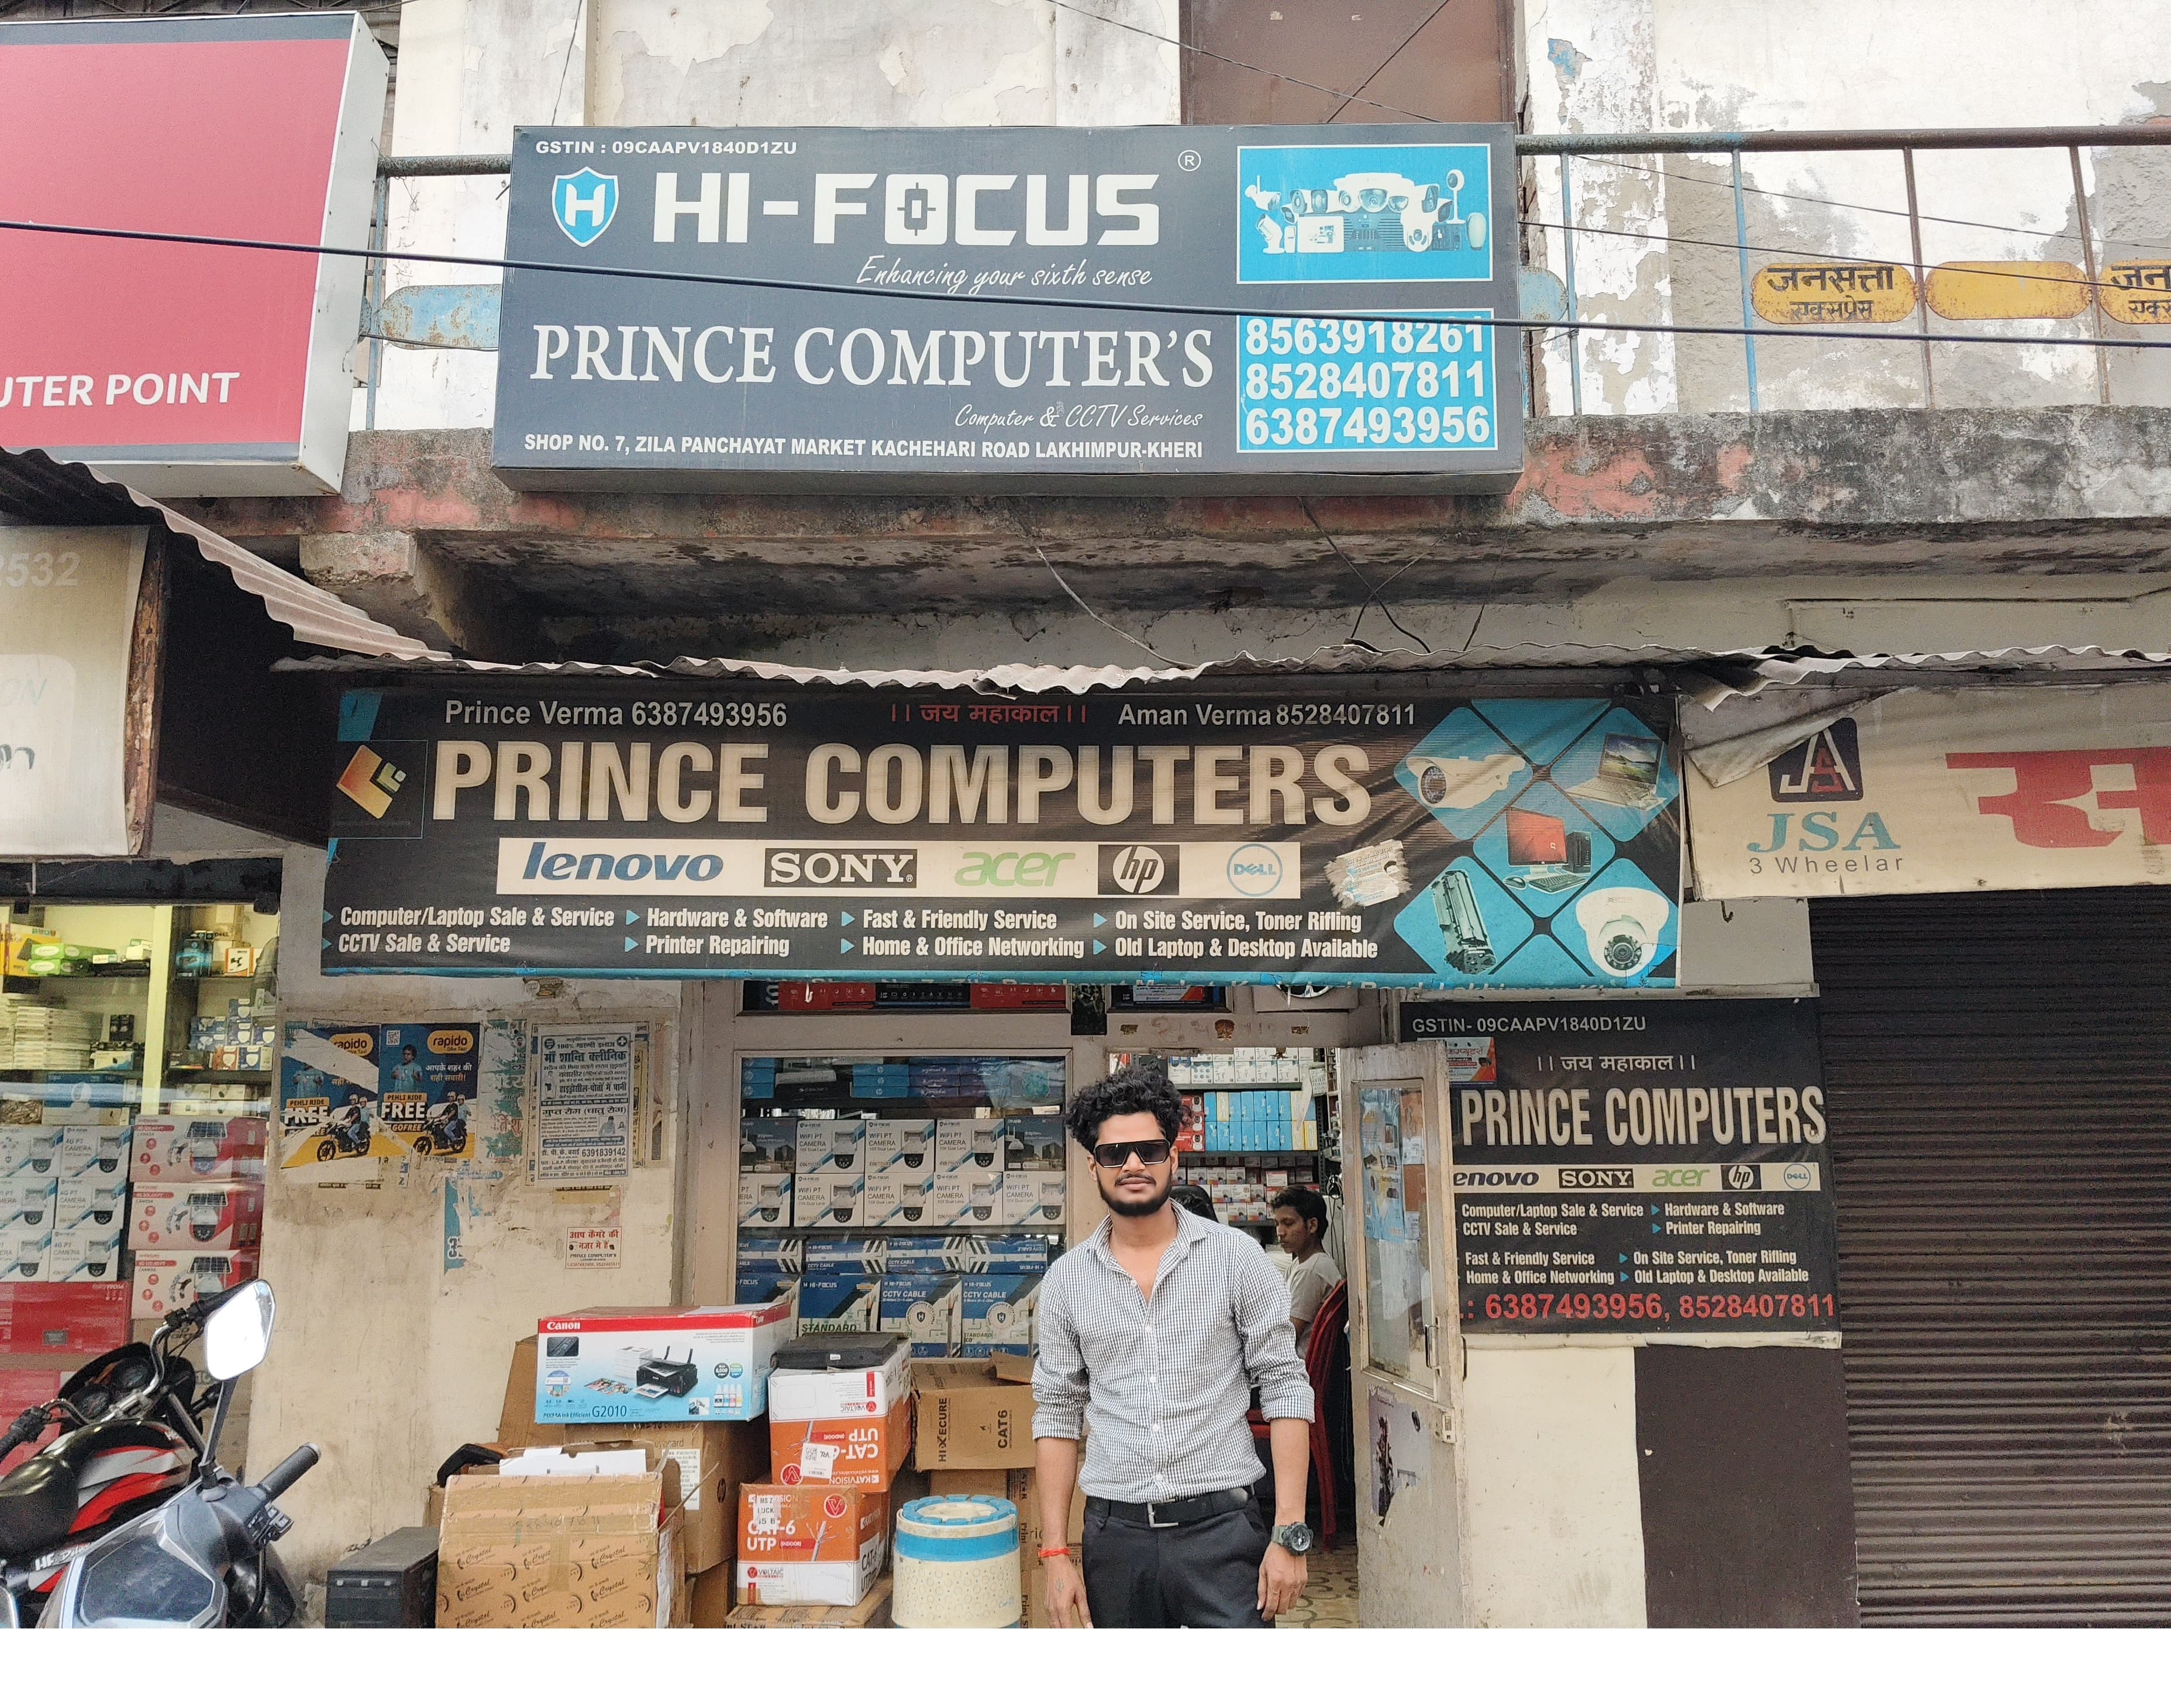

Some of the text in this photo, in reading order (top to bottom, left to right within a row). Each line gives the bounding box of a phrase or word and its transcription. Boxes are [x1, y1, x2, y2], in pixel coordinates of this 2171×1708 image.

[536, 142, 797, 155] GSTIN 09CAAPV1840D1ZU
[653, 173, 1160, 246] HI-FOCUS
[857, 254, 1152, 295] Enhancing your sixth sense
[1246, 316, 1485, 356] 8563918261
[530, 325, 776, 383] PRINCE
[106, 371, 240, 405] POINT
[1246, 360, 1486, 401] 8528407811
[956, 404, 1203, 434] Computer & CCTV Services
[1246, 406, 1490, 445] 6387493956
[525, 434, 1203, 459] SHOP NO. 7, ZILA PANCHAYAT MARKET KACHEHARI ROAD LAKHIMPUR-KHERI
[446, 700, 787, 727] Prince Verma 6387493956
[920, 704, 1059, 724] जय महाकाल
[1118, 704, 1415, 725] Aman Verma 8528407811
[433, 740, 1371, 826] PRINCE COMPUTERS
[1746, 812, 1901, 853] JSA
[523, 842, 1277, 894] lenovo SONY acer hp DELL
[1749, 855, 1903, 875] 3 Wheelar
[341, 907, 615, 928] Computer/Laptop Sale & Service
[647, 908, 828, 928] Hardware & Software
[863, 910, 1057, 931] Fast & Friendly Service
[1115, 911, 1138, 930] On
[1143, 911, 1176, 931] Site
[1182, 911, 1250, 932] Service,
[1256, 911, 1302, 931] Toner
[339, 934, 510, 953] CCTV Sale & Service
[646, 936, 790, 957] Printer Repairing
[863, 937, 1084, 958] Home & Office Networking
[1115, 938, 1378, 960] Old Laptop & Desktop Available
[1412, 1017, 1646, 1033] GSTIN- 09CAAPV1840D1ZU
[433, 1034, 467, 1050] rapido
[1560, 1055, 1674, 1073] जय महाकाल
[381, 1102, 426, 1118] FREE
[1462, 1086, 1827, 1146] PRINCE COMPUTERS
[582, 1148, 626, 1157] 6391839142
[1453, 1172, 1539, 1186] enovo
[1562, 1171, 1631, 1186] SONY
[1652, 1169, 1710, 1187] acer
[1732, 1166, 1751, 1189] hp
[1462, 1203, 1643, 1218] Computer/Laptop Sale & Service
[1665, 1202, 1784, 1216] Hardware & Software
[1463, 1223, 1577, 1235] CCTV Sale & Service
[1666, 1221, 1761, 1235] Printer Repairing
[1465, 1252, 1595, 1267] Fast & Friendly Service
[1634, 1251, 1649, 1265] On
[1652, 1251, 1674, 1265] Site
[1677, 1251, 1724, 1265] Service,
[1726, 1251, 1757, 1264] Toner
[1466, 1270, 1615, 1285] Home & Office Networking
[1635, 1269, 1808, 1285] Old Laptop & Desktop Available
[1486, 1293, 1670, 1323] 6387493956,
[1679, 1293, 1834, 1318] 8528407811
[547, 1321, 580, 1331] Canon
[802, 1324, 858, 1333] STANDARD
[592, 1406, 628, 1418] G2010
[849, 1428, 878, 1442] UTP
[998, 1410, 1008, 1448] CAT6
[747, 1538, 777, 1551] UTP
